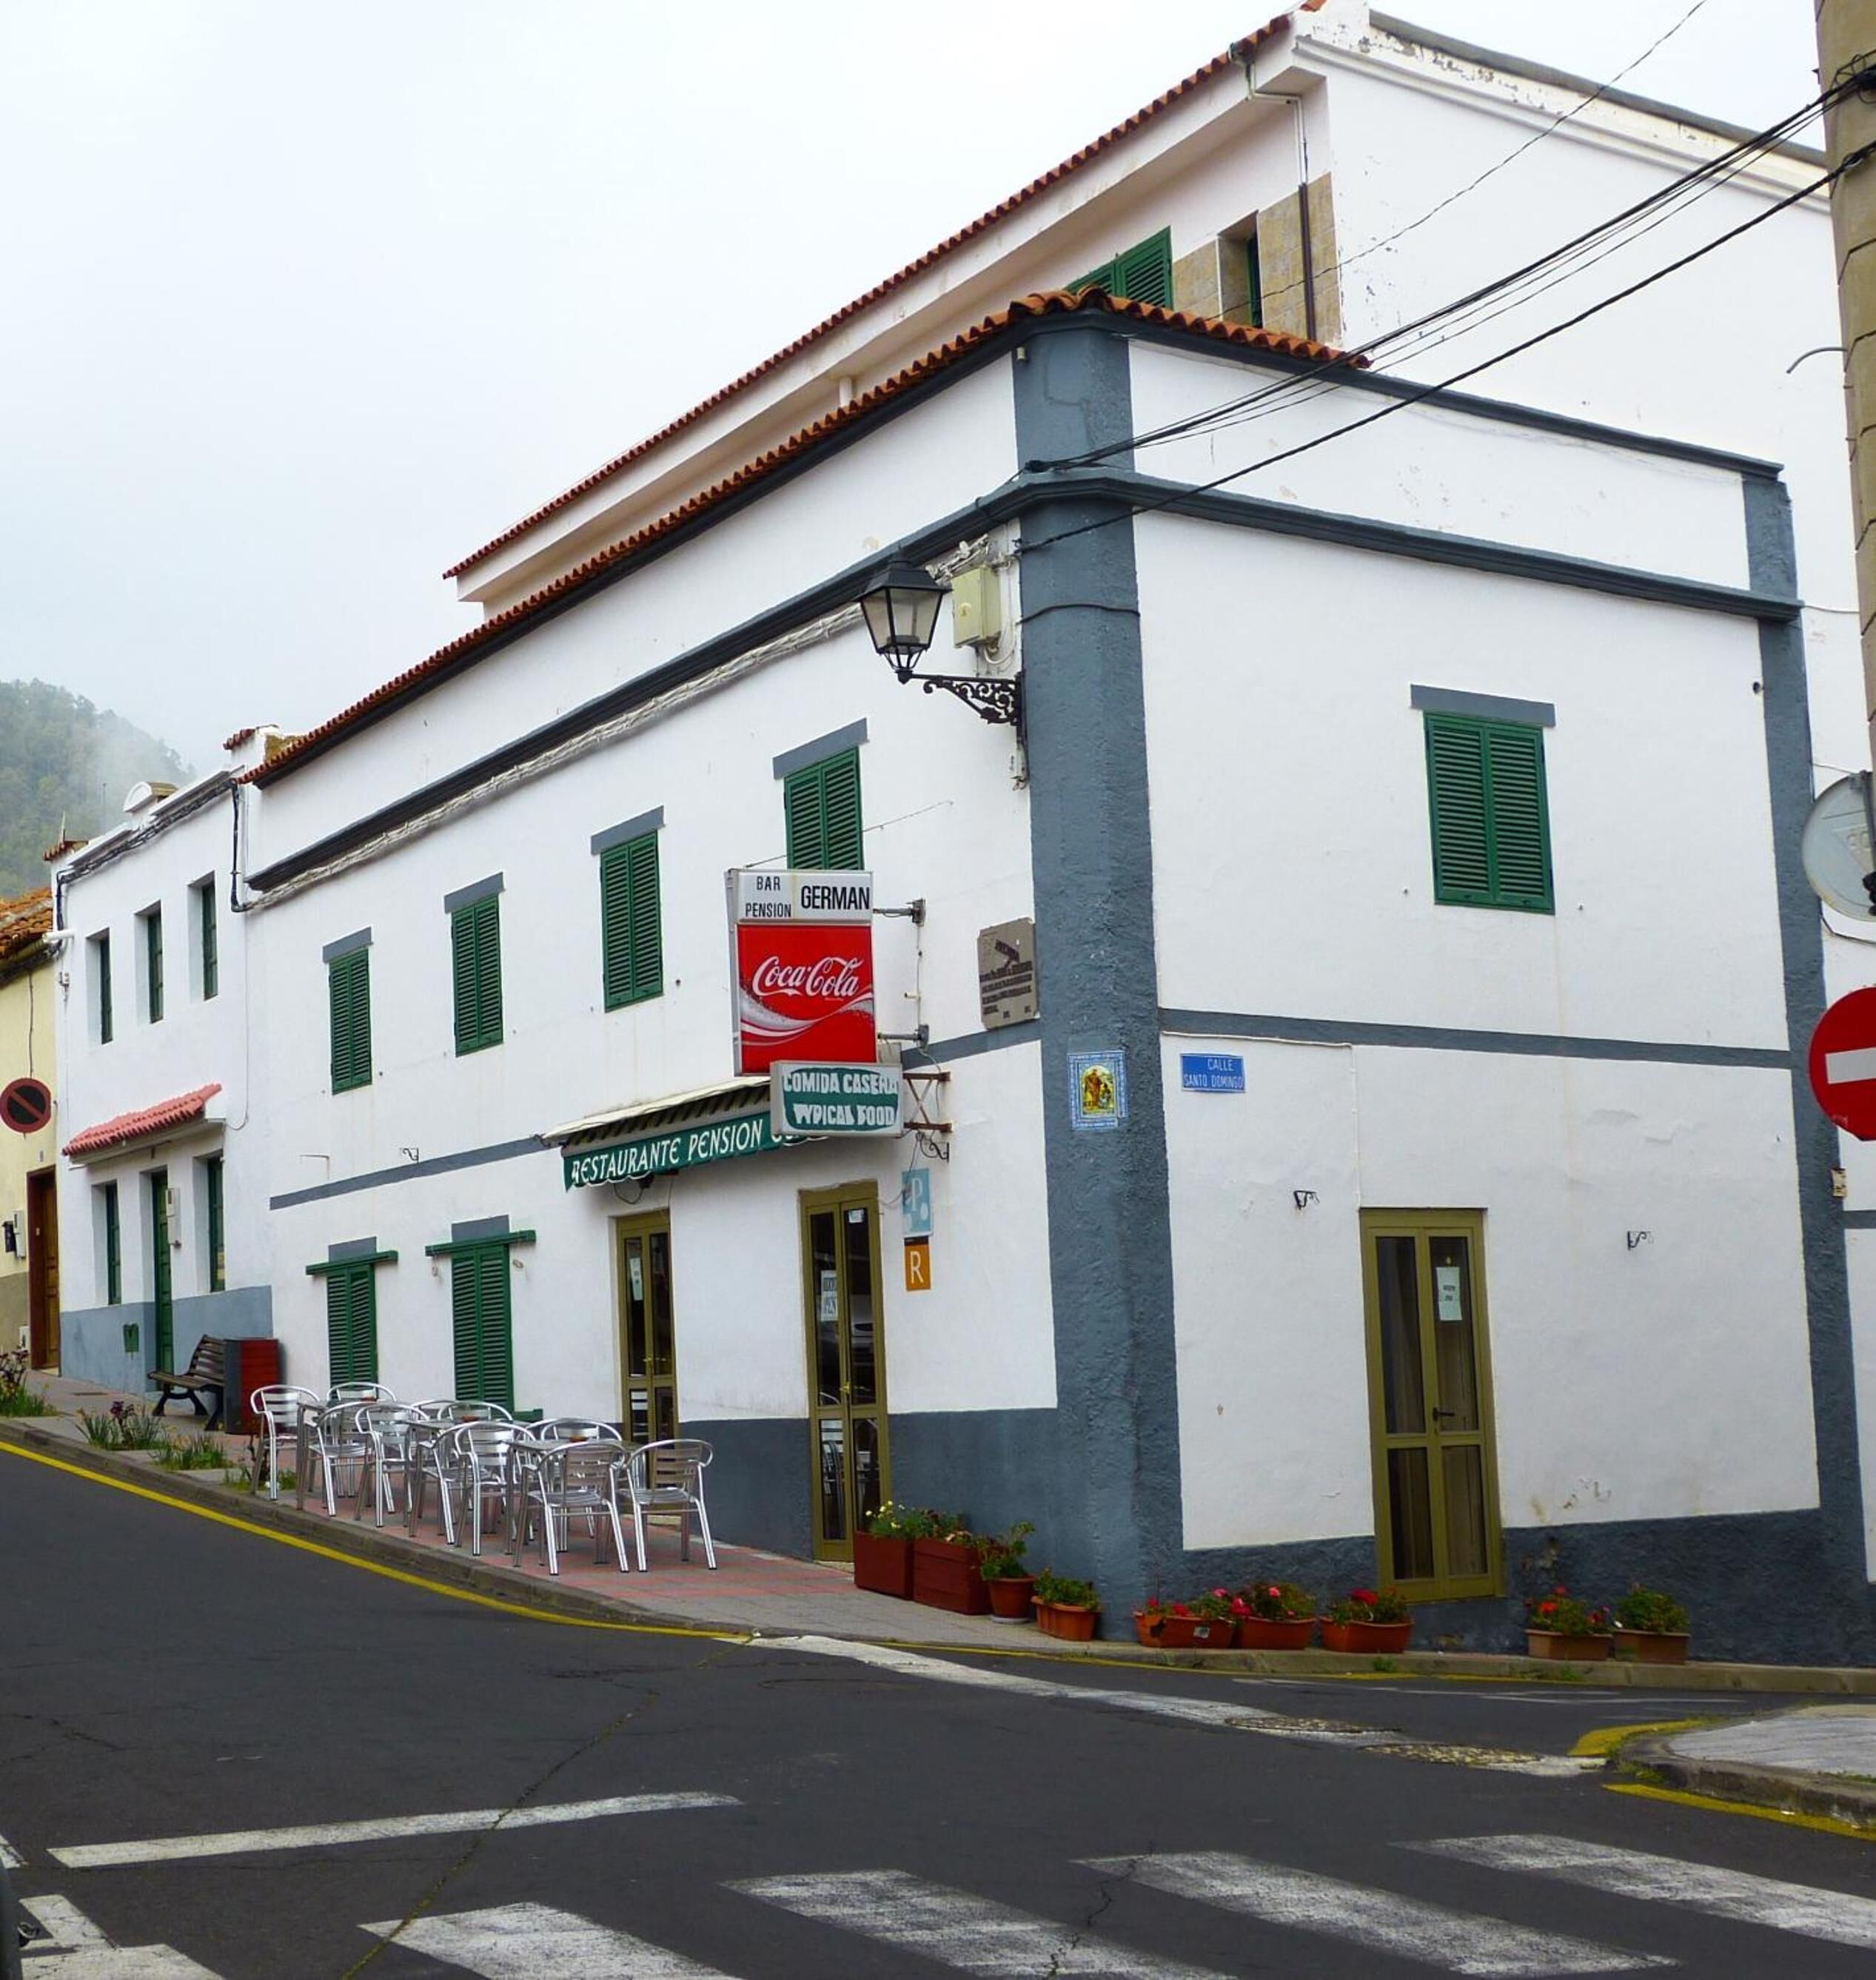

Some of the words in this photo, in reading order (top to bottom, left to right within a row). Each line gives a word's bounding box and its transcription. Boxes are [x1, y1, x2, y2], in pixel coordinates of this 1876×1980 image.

[756, 876, 781, 891] BAR
[800, 885, 870, 910] GERMAN
[745, 902, 791, 919] PENSION
[1207, 1058, 1233, 1072] CALLE
[783, 1072, 840, 1094] COMIDA
[842, 1073, 899, 1095] CASERA
[1184, 1073, 1207, 1087] SANTO
[1211, 1075, 1244, 1090] DOMINGO
[856, 1105, 895, 1126] FOOD
[571, 1137, 682, 1184] RESTAURANTE
[687, 1118, 763, 1161] PENSION
[910, 1251, 925, 1284] R
